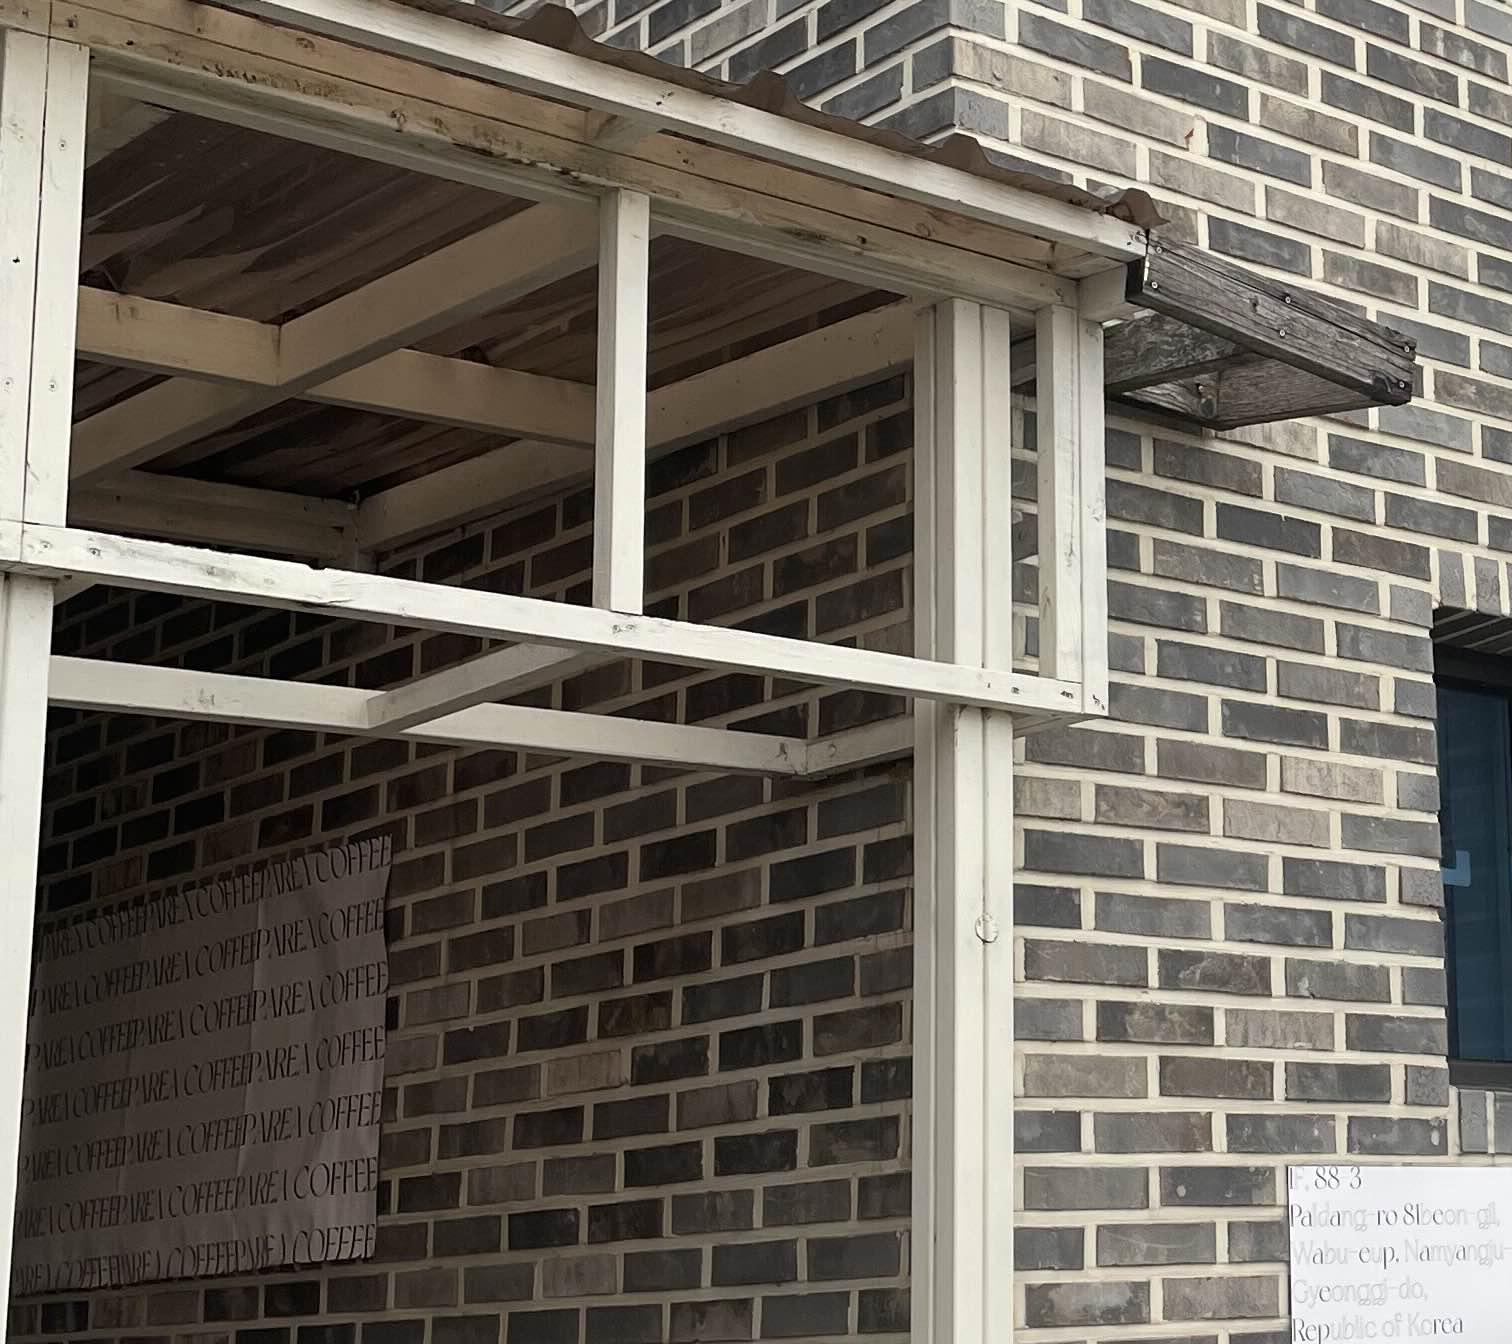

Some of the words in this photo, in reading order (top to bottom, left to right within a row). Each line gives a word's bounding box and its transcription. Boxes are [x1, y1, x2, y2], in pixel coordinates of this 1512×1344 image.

[319, 896, 384, 945] COFFEE
[320, 960, 388, 1009] COFFEE
[316, 1024, 385, 1072] COFFEE
[308, 1090, 382, 1136] COFFEE
[293, 1156, 377, 1200] COFFEE
[1382, 1312, 1402, 1338] of
[1408, 1312, 1464, 1337] Korea
